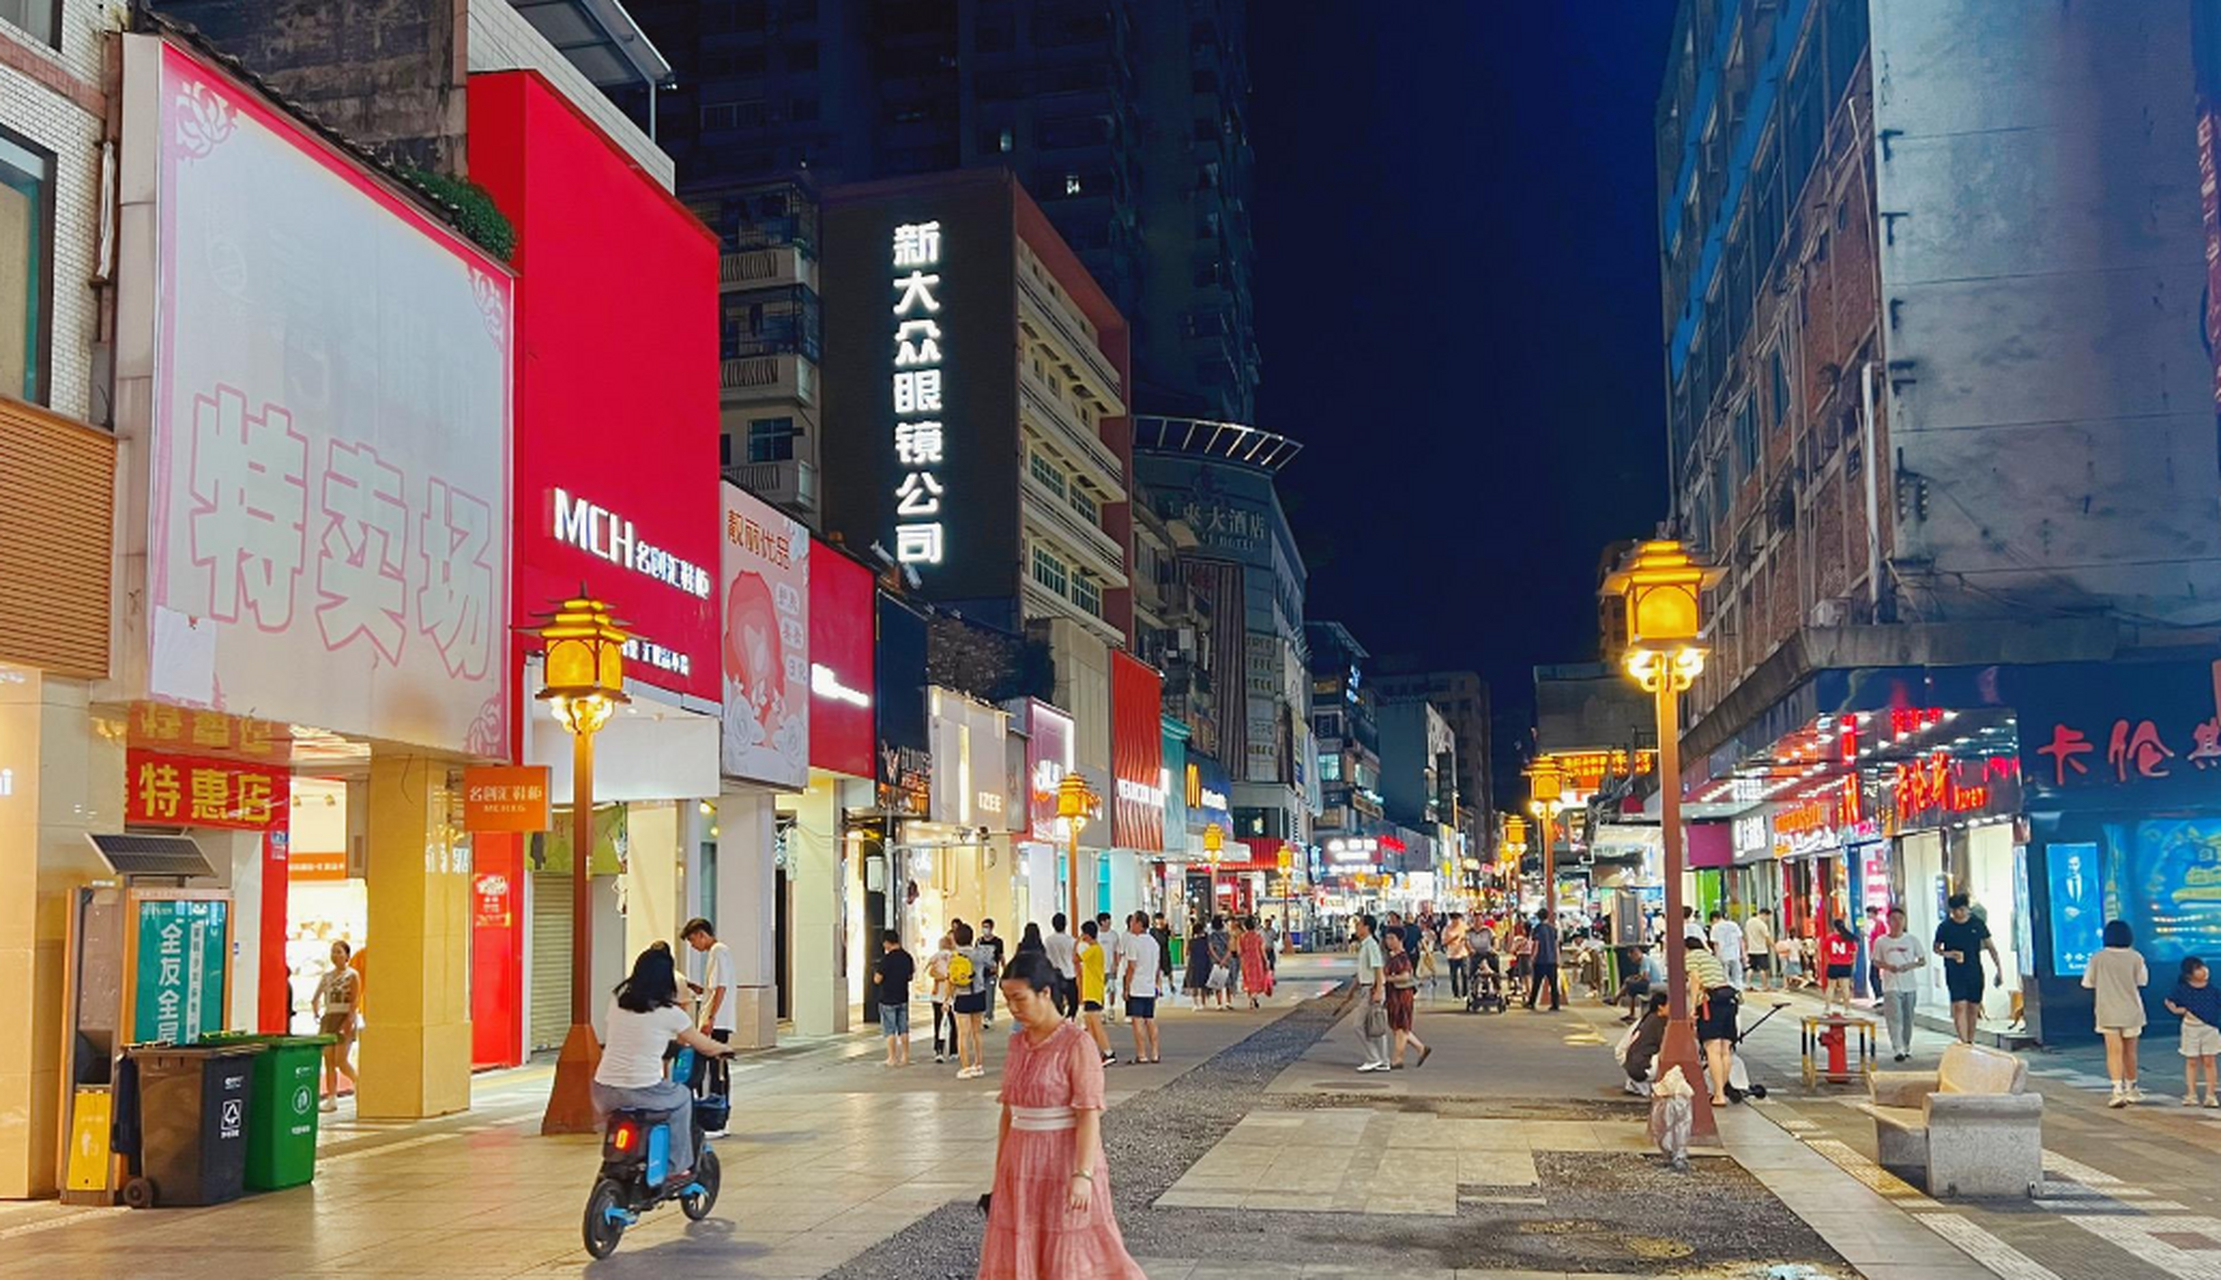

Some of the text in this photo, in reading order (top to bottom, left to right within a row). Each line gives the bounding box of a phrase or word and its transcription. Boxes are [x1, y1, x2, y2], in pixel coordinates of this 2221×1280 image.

[893, 221, 943, 564] 新大众眼镜公司
[190, 382, 493, 680] 特卖场
[554, 487, 711, 600] MCH 名创汇鞋柜
[727, 509, 791, 570] 靓丽优品
[139, 762, 272, 822] 特惠店
[469, 785, 543, 801] 名创汇鞋柜
[1831, 941, 1847, 955] N
